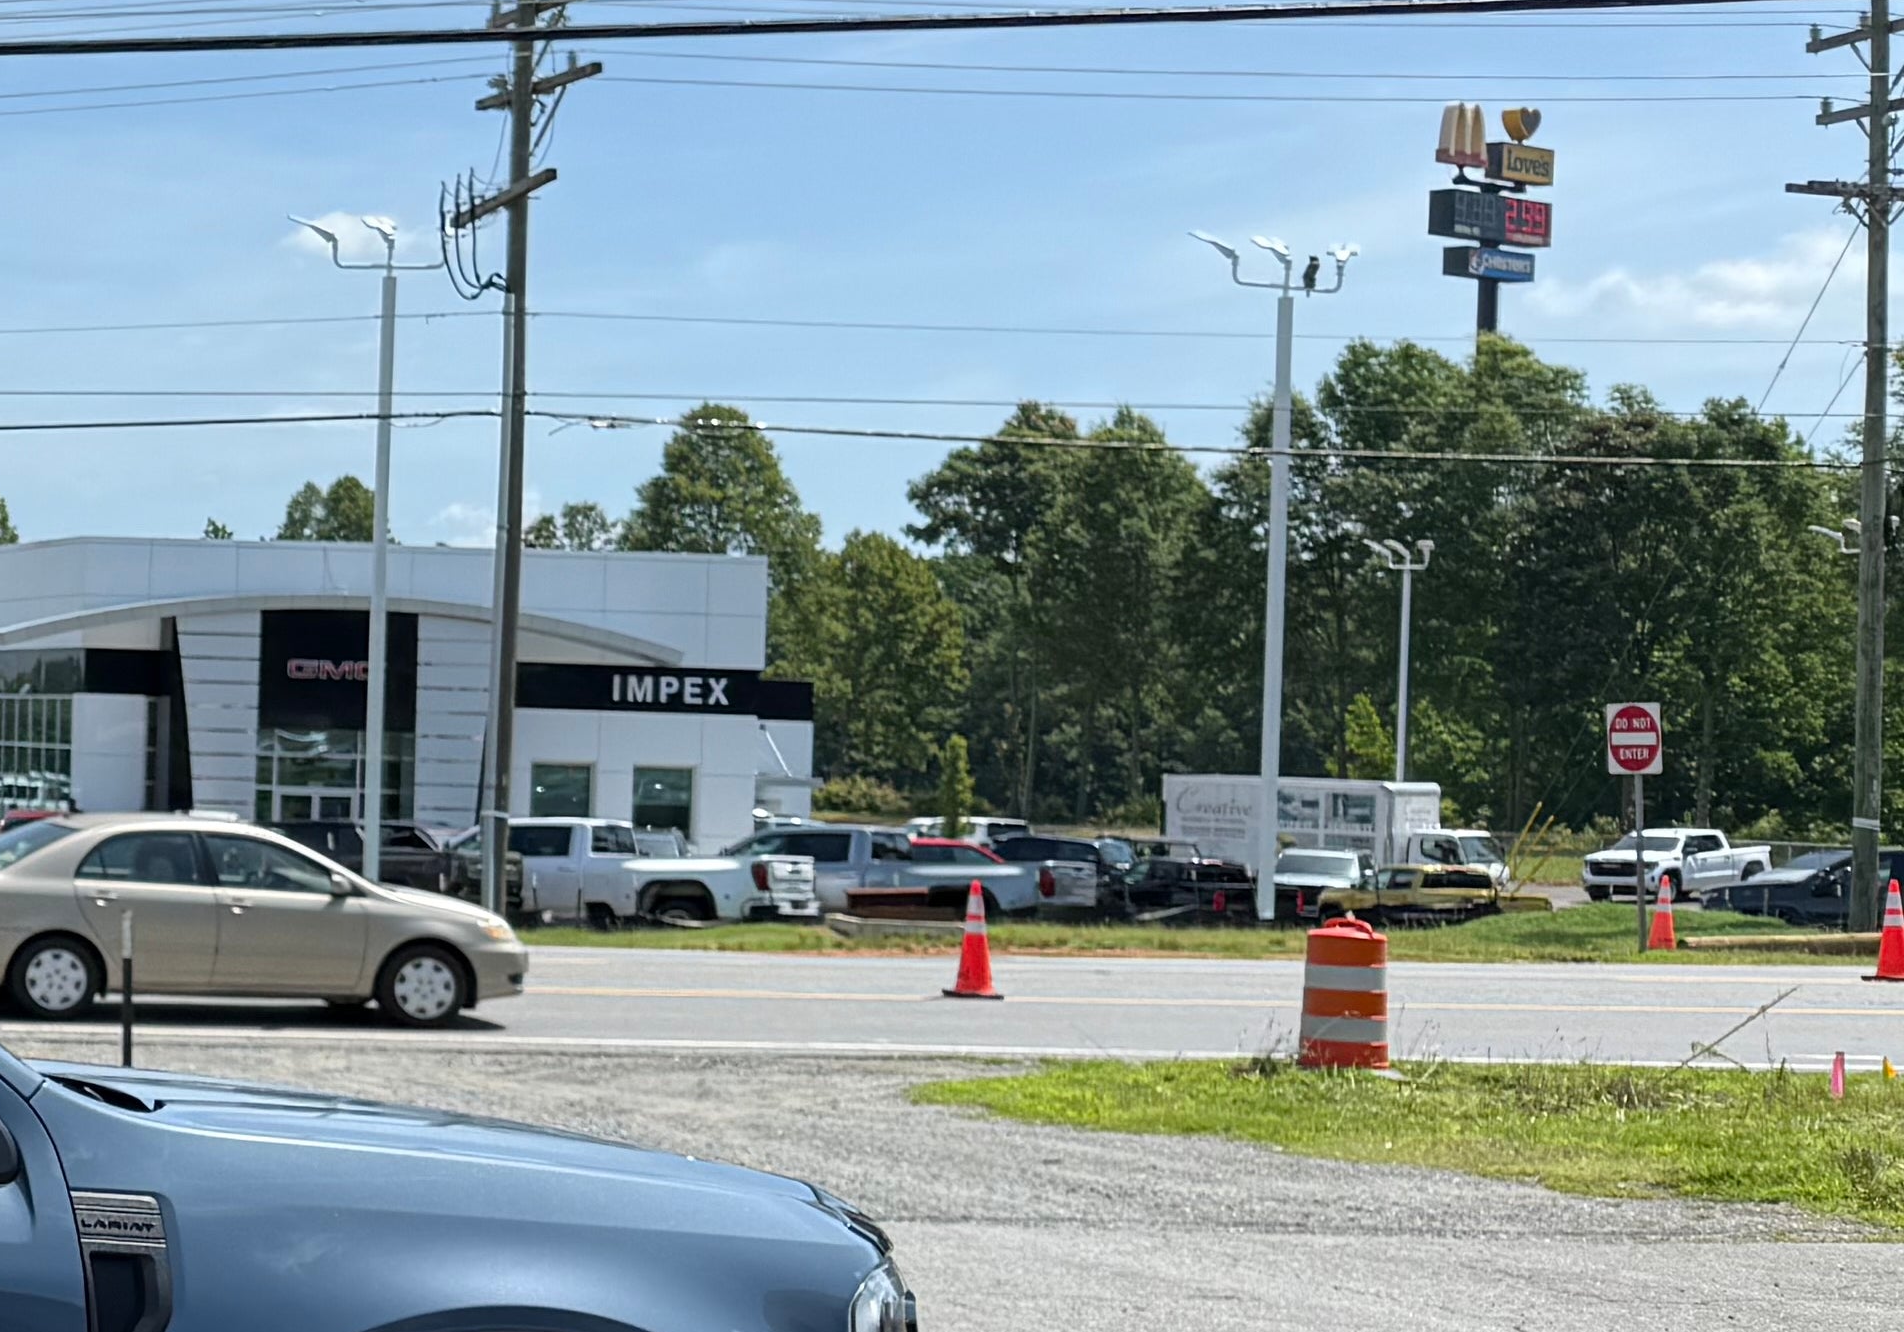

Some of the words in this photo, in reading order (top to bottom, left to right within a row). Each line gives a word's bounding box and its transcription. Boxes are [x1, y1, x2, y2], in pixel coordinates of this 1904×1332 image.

[612, 673, 730, 706] IMPEX
[1615, 717, 1629, 730] DO
[1632, 717, 1651, 730] NOT
[1619, 748, 1649, 760] ENTER
[1176, 785, 1253, 817] Creative
[80, 1218, 155, 1233] LARIAT
